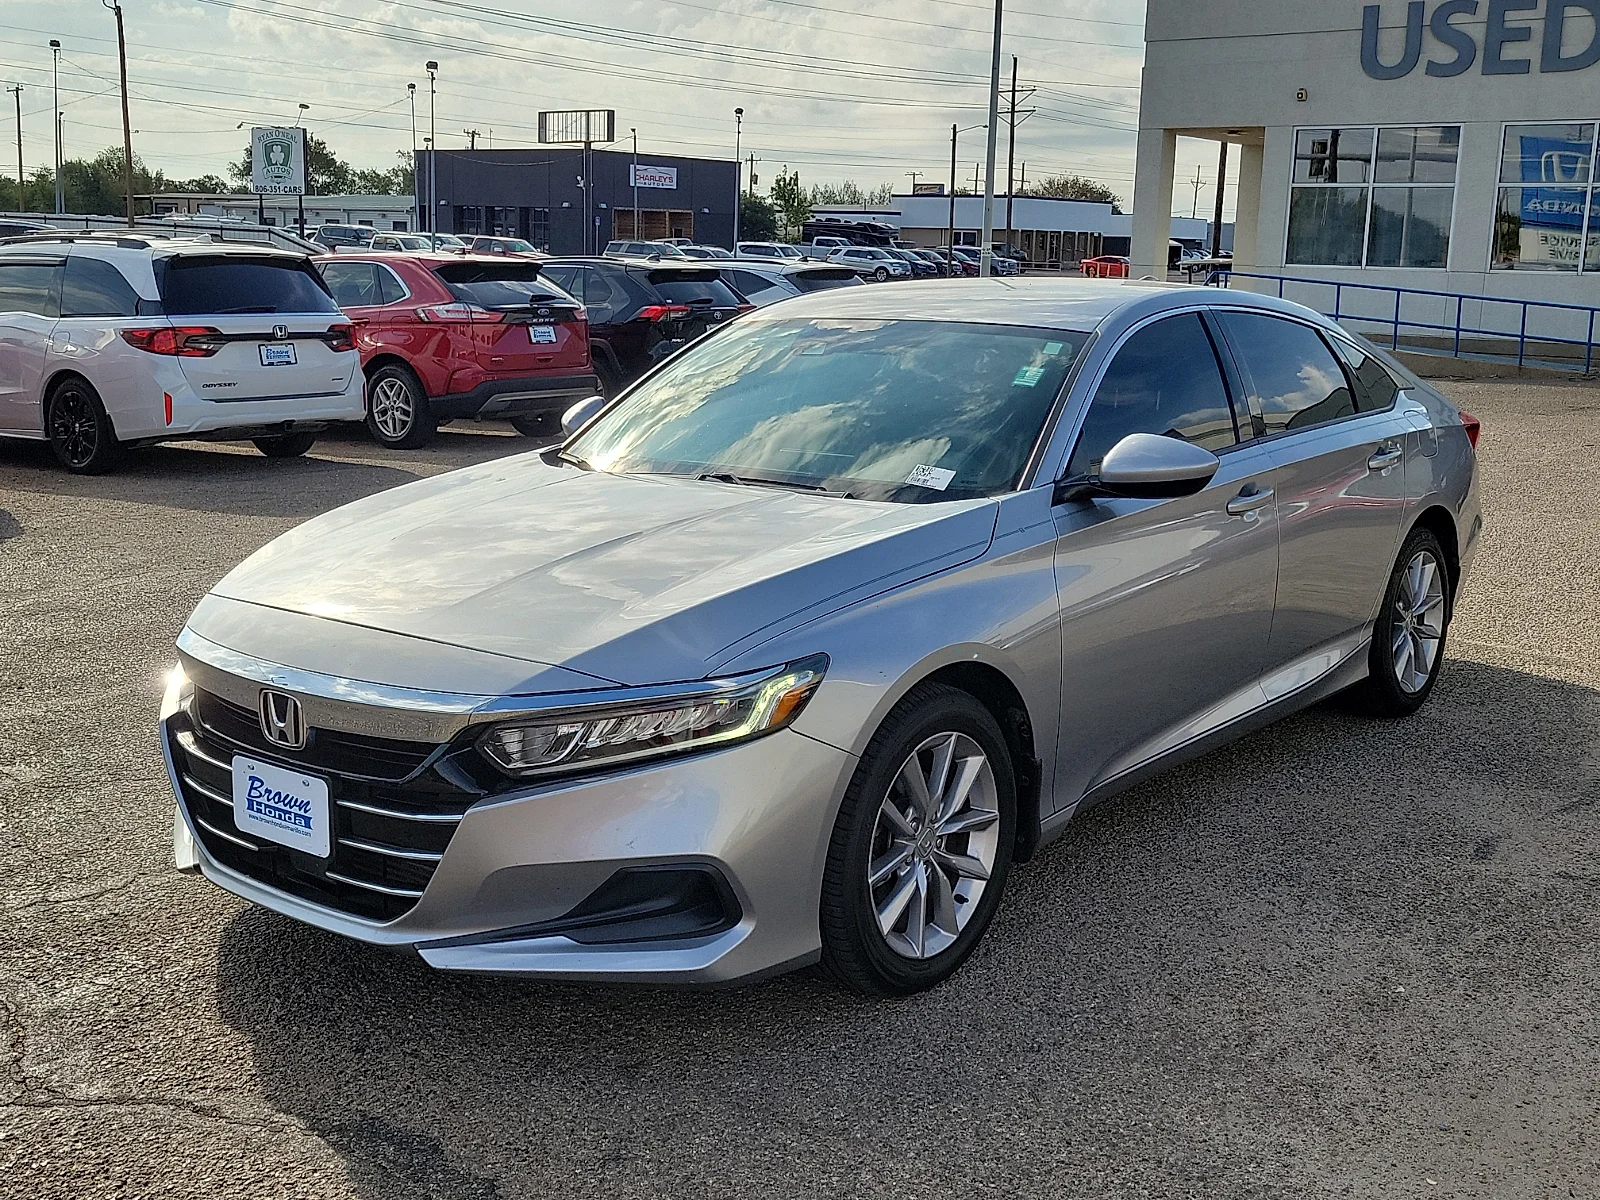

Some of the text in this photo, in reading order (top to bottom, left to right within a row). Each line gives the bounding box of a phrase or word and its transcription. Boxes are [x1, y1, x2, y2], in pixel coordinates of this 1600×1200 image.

[1360, 0, 1600, 80] USED
[257, 131, 274, 143] RYAN
[265, 167, 291, 175] AUTOS
[254, 185, 302, 193] 806-351-CARS
[247, 775, 311, 814] Brown
[253, 800, 306, 827] Honda
